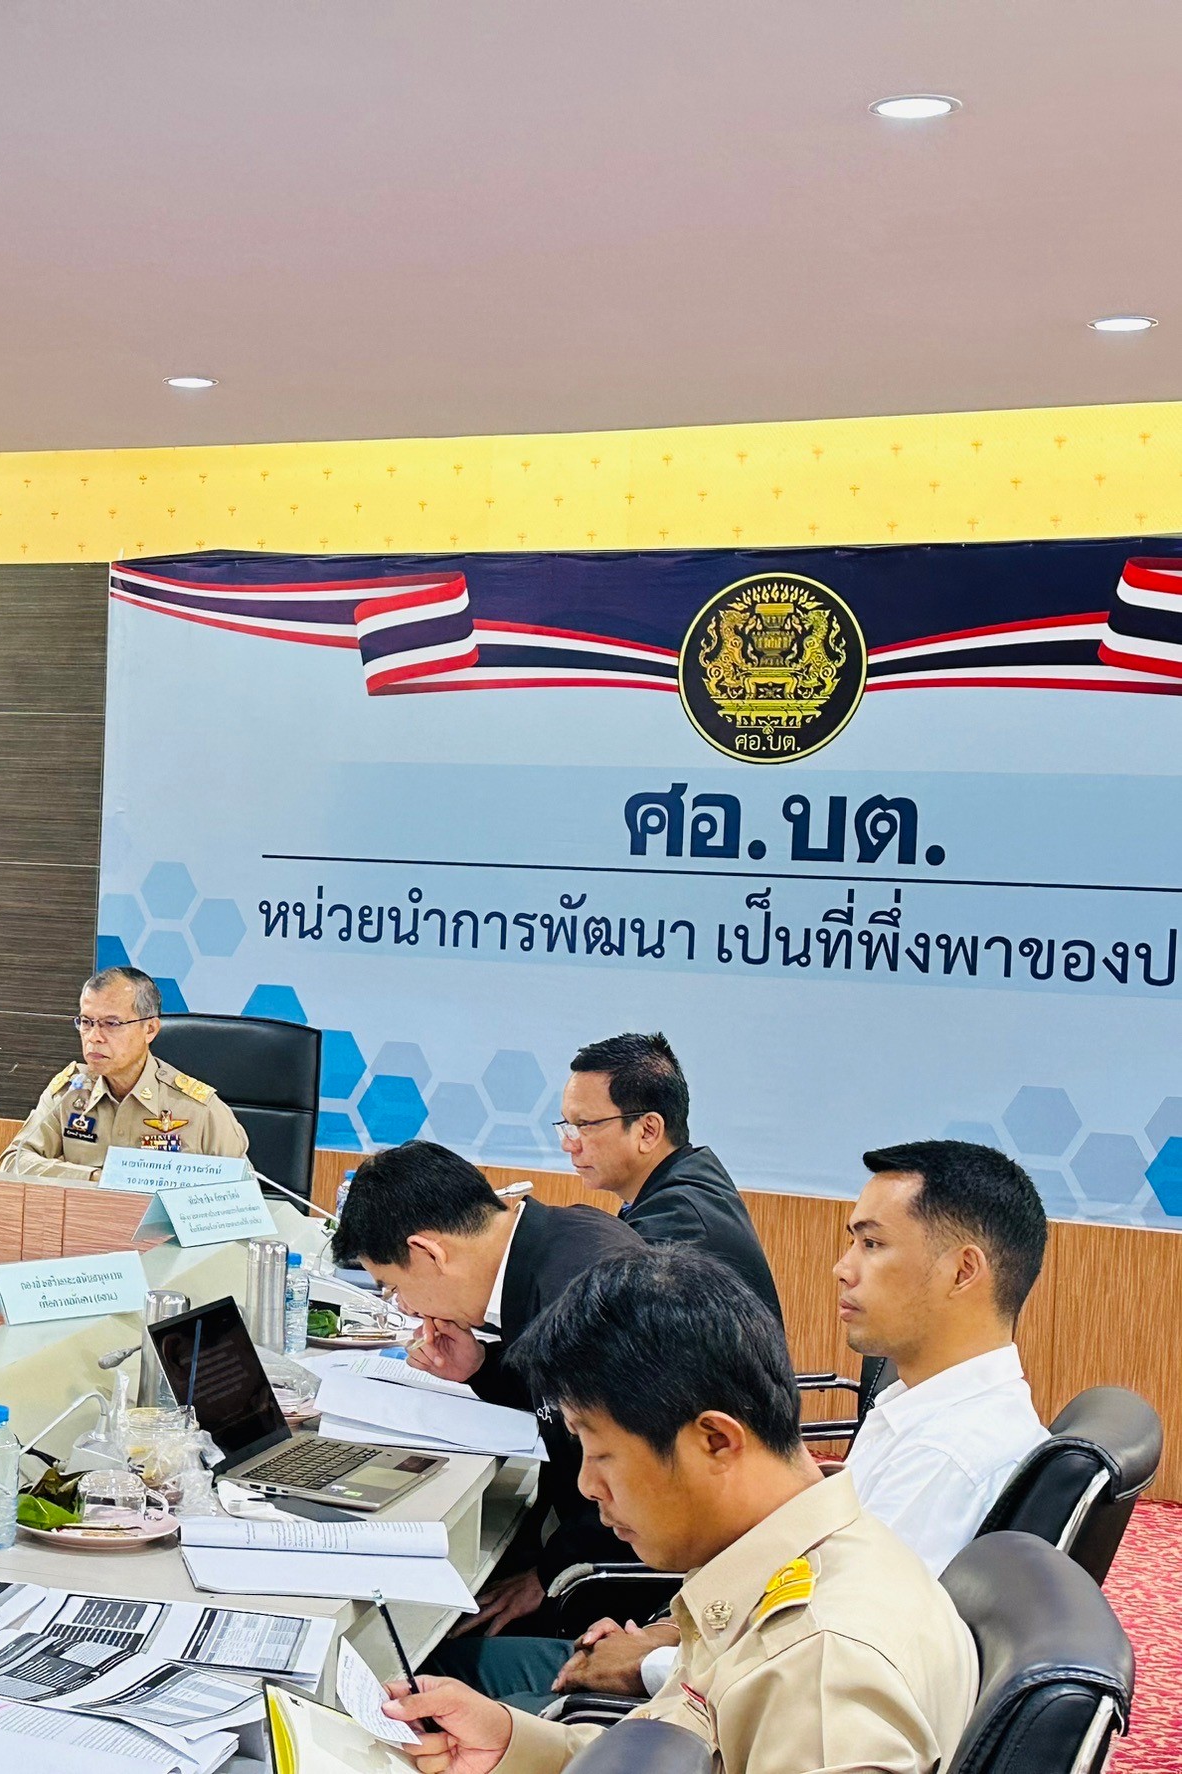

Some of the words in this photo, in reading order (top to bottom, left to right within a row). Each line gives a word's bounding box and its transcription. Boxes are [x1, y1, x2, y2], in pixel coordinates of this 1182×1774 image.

[734, 733, 802, 752] ศอ.บต.
[625, 783, 945, 866] ศอ.บต.
[259, 886, 695, 960] หน่วยนำการพัฒนา
